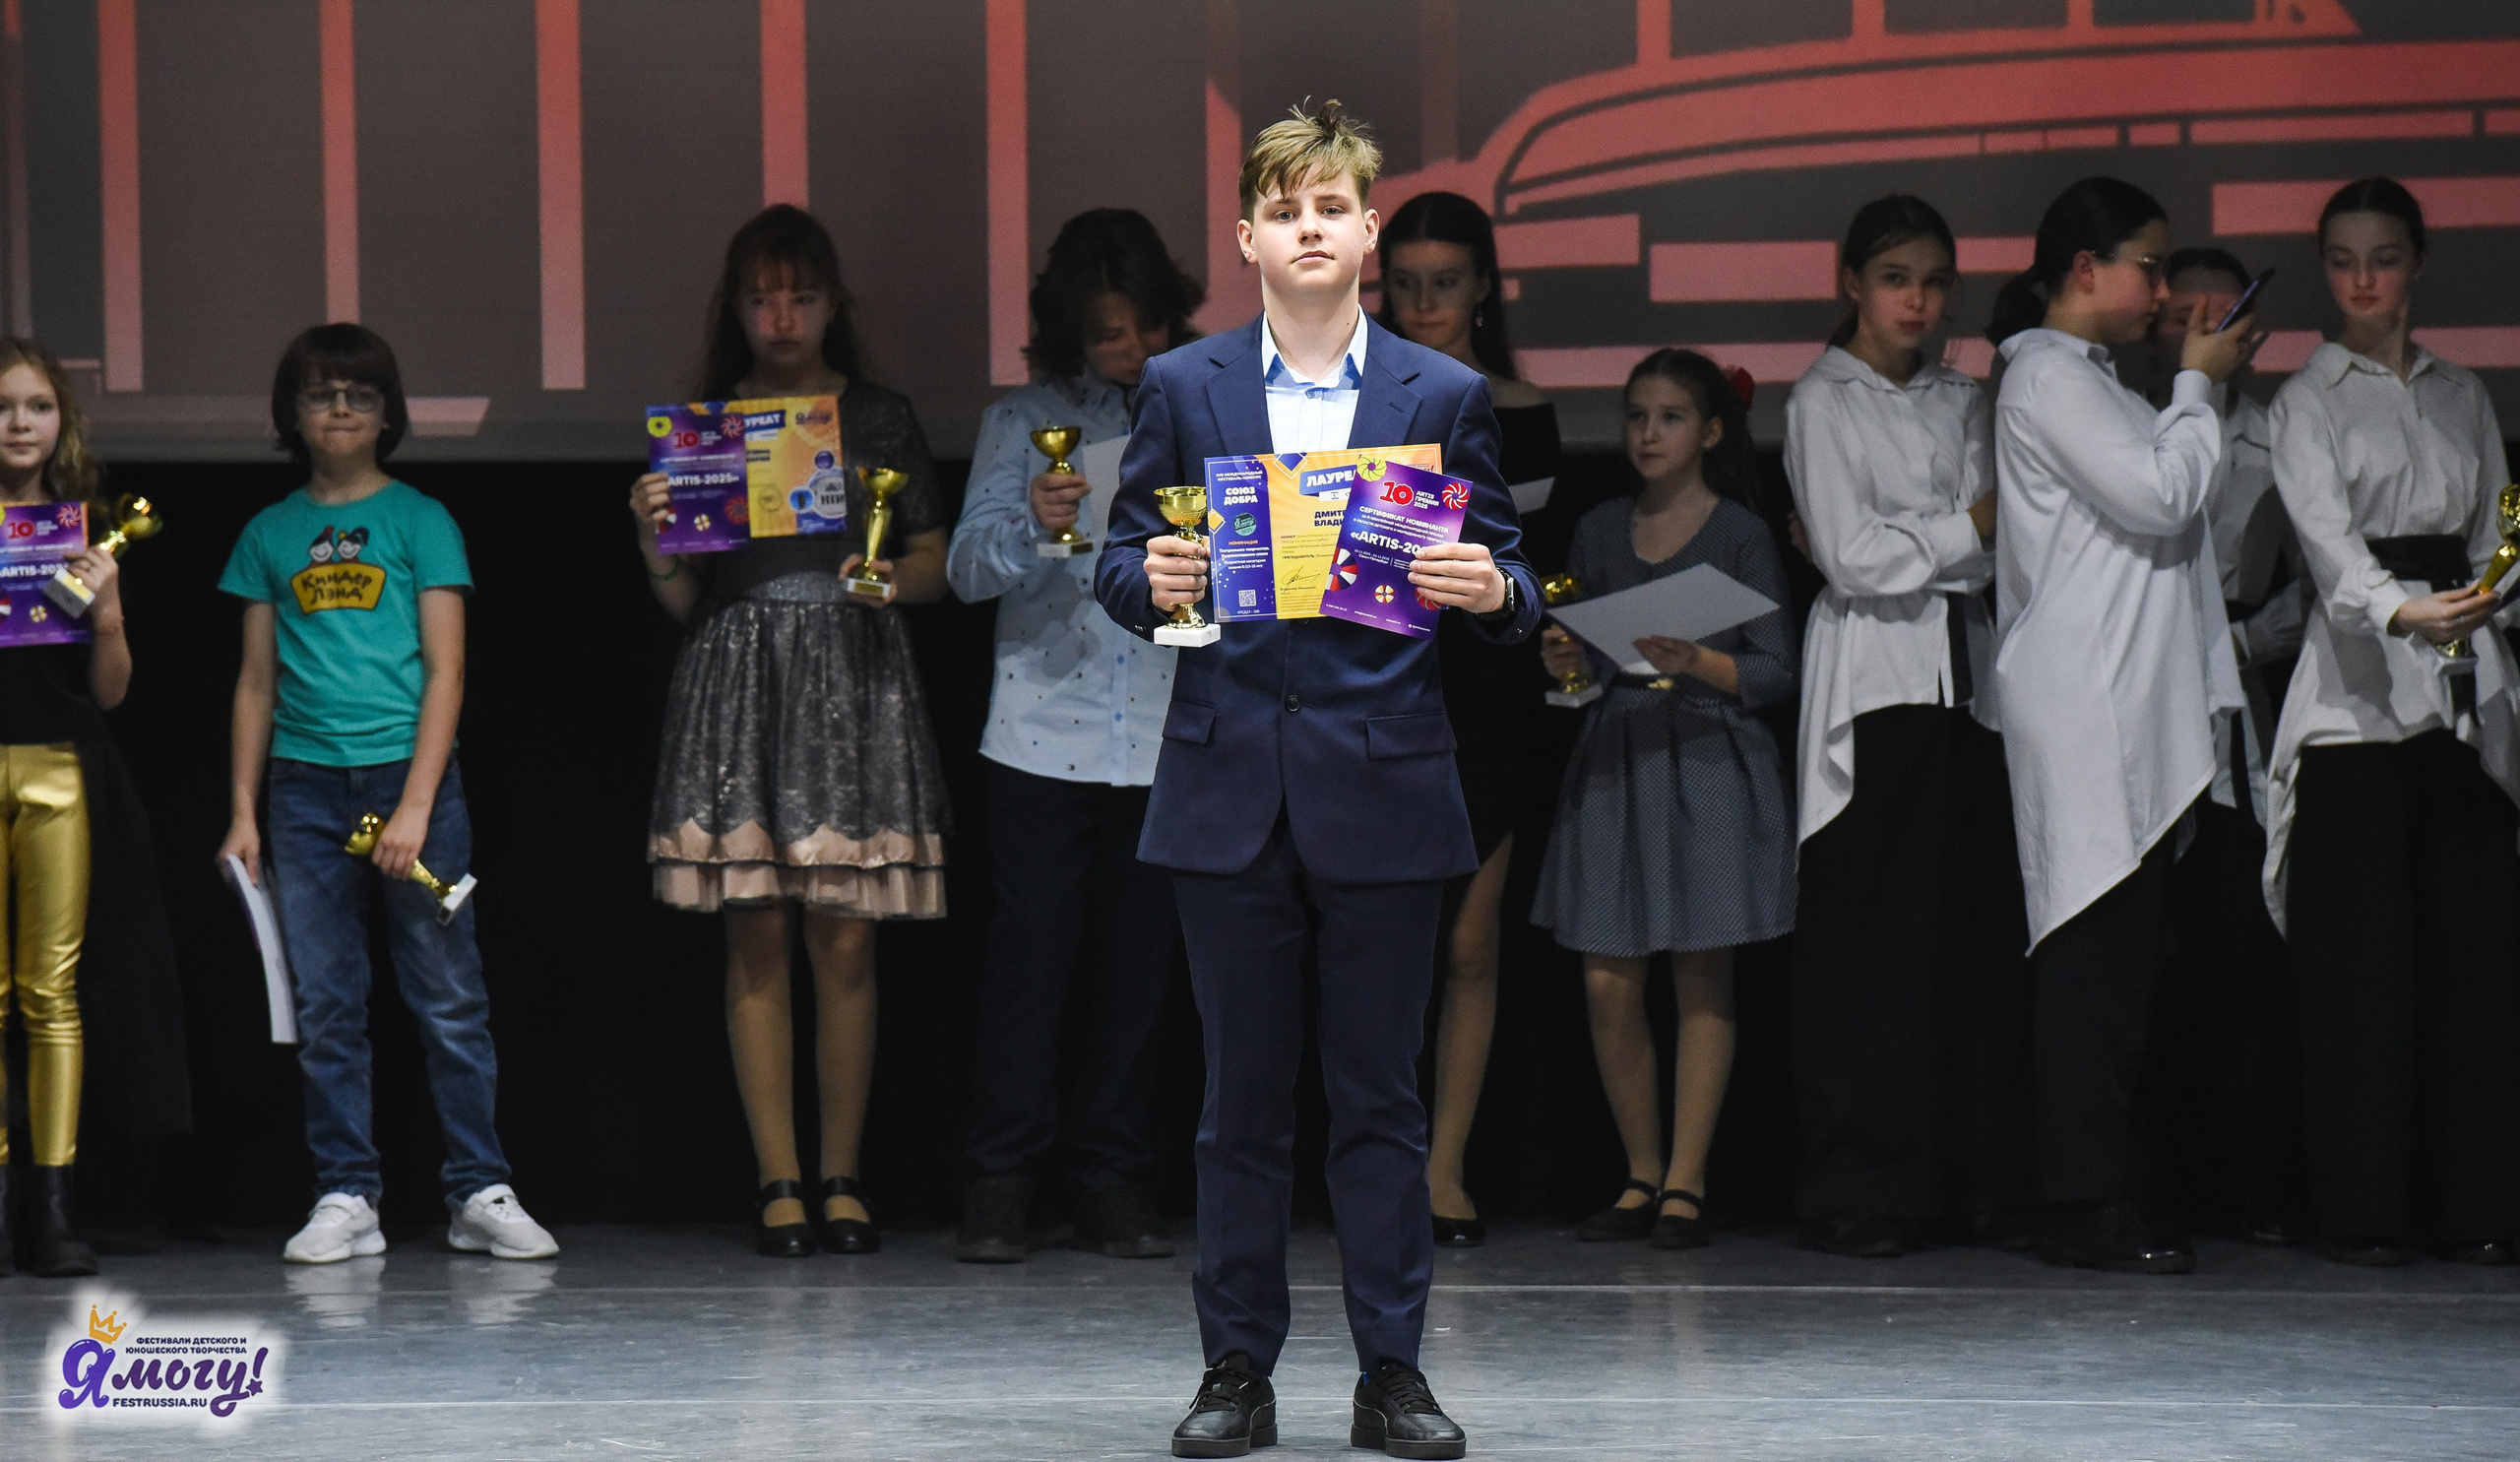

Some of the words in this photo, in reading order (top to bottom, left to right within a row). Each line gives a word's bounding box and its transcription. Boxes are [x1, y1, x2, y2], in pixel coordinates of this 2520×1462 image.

[674, 431, 699, 449] 10
[1306, 469, 1355, 486] ЛАУРЕ
[1225, 486, 1256, 496] СОЮЗ
[1380, 481, 1414, 506] 10
[1416, 490, 1434, 499] ARTIS
[1224, 495, 1259, 506] ДОБРА
[1415, 495, 1440, 506] ПРЕМИЯ
[1359, 505, 1405, 522] СЕРТИФИКАТ
[1406, 517, 1448, 534] НОМИНАНТА
[8, 521, 36, 539] 10
[1351, 531, 1425, 554] «ARTIS-20
